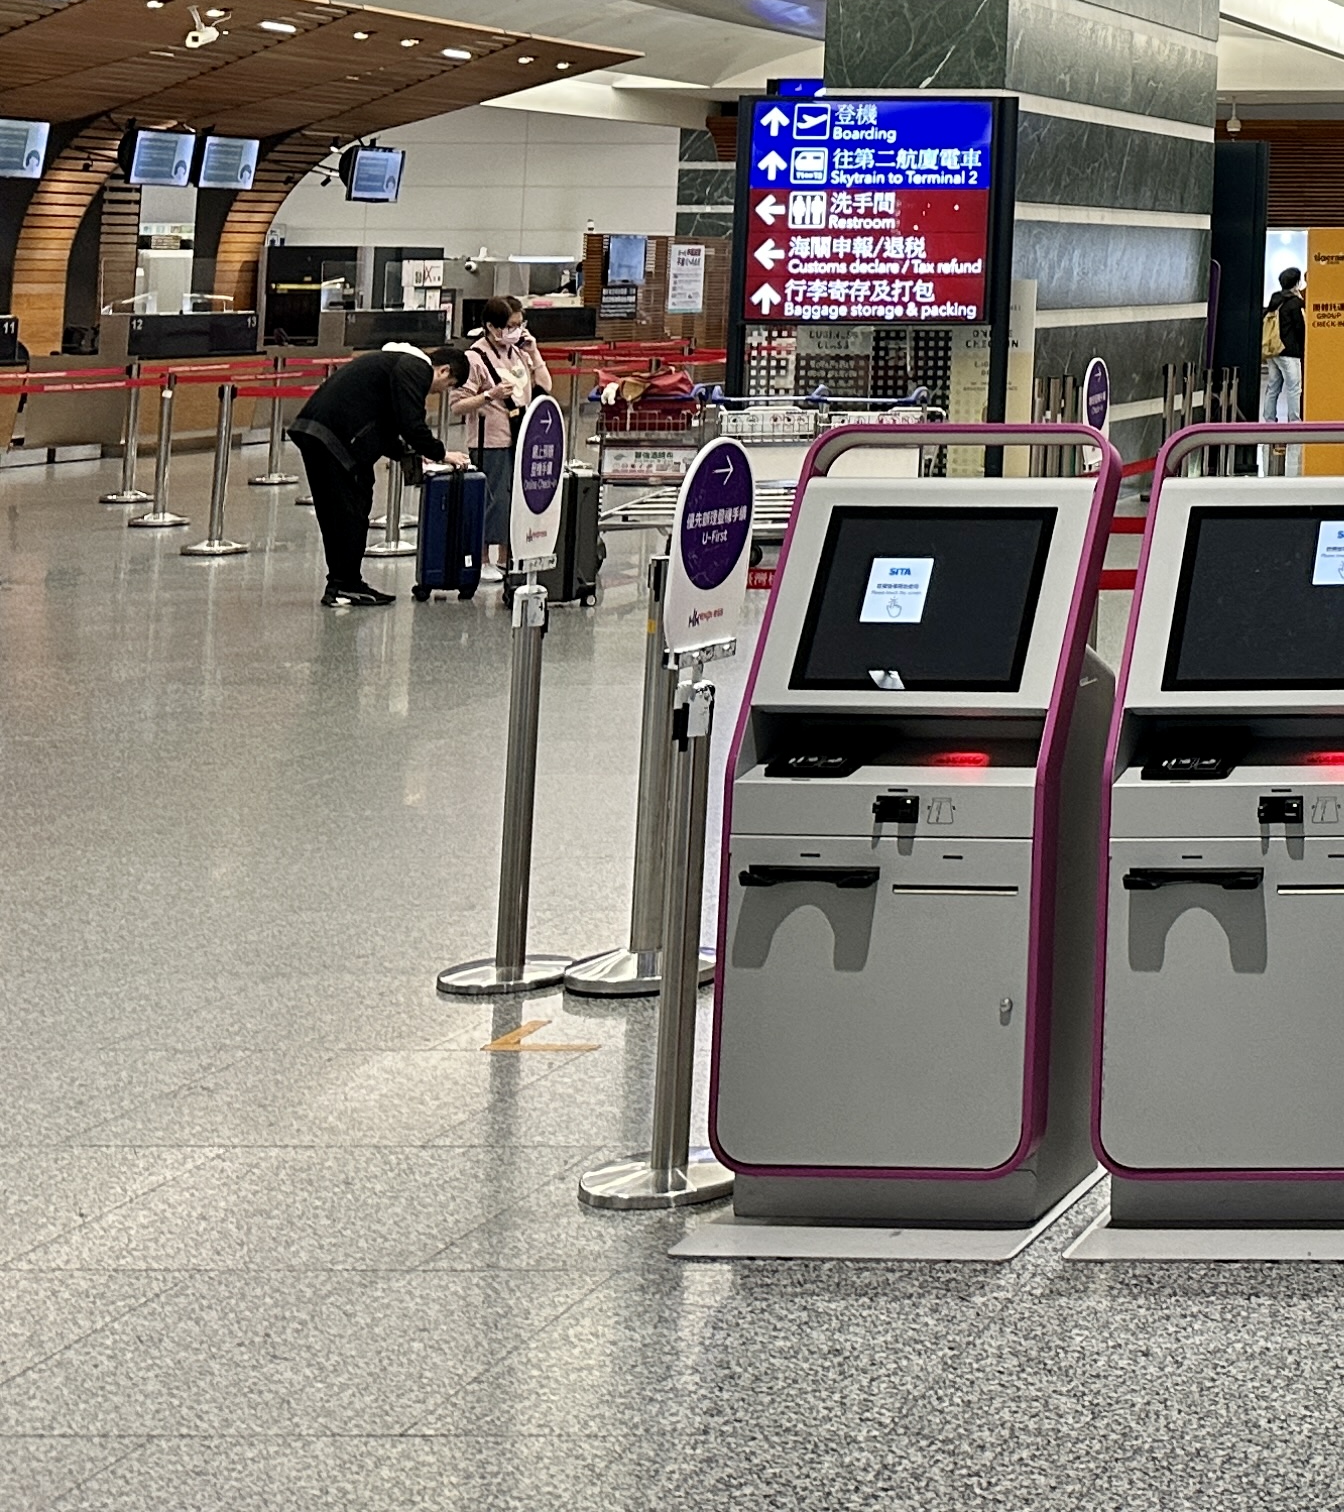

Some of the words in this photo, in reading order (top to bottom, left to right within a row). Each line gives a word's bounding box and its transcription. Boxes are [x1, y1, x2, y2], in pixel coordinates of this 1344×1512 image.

[835, 104, 878, 125] 登機
[832, 127, 897, 143] Boarding
[832, 148, 982, 170] 往第二航廈電車
[830, 171, 885, 187] Skytrain
[887, 172, 903, 184] to
[905, 171, 966, 184] Terminal
[967, 171, 978, 185] 2
[830, 192, 896, 214] 洗手間
[828, 215, 896, 229] Restroom
[787, 259, 848, 274] Customs
[849, 259, 900, 274] declare
[911, 260, 935, 274] Tax
[937, 258, 982, 274] refund
[784, 279, 936, 302] 行李寄存及打包
[784, 302, 848, 319] Baggage
[850, 303, 904, 319] storage
[905, 303, 918, 317] &
[920, 301, 977, 319] packing
[3, 322, 15, 334] 11
[131, 319, 143, 331] 12
[702, 529, 728, 545] U-First
[889, 568, 911, 576] SITA
